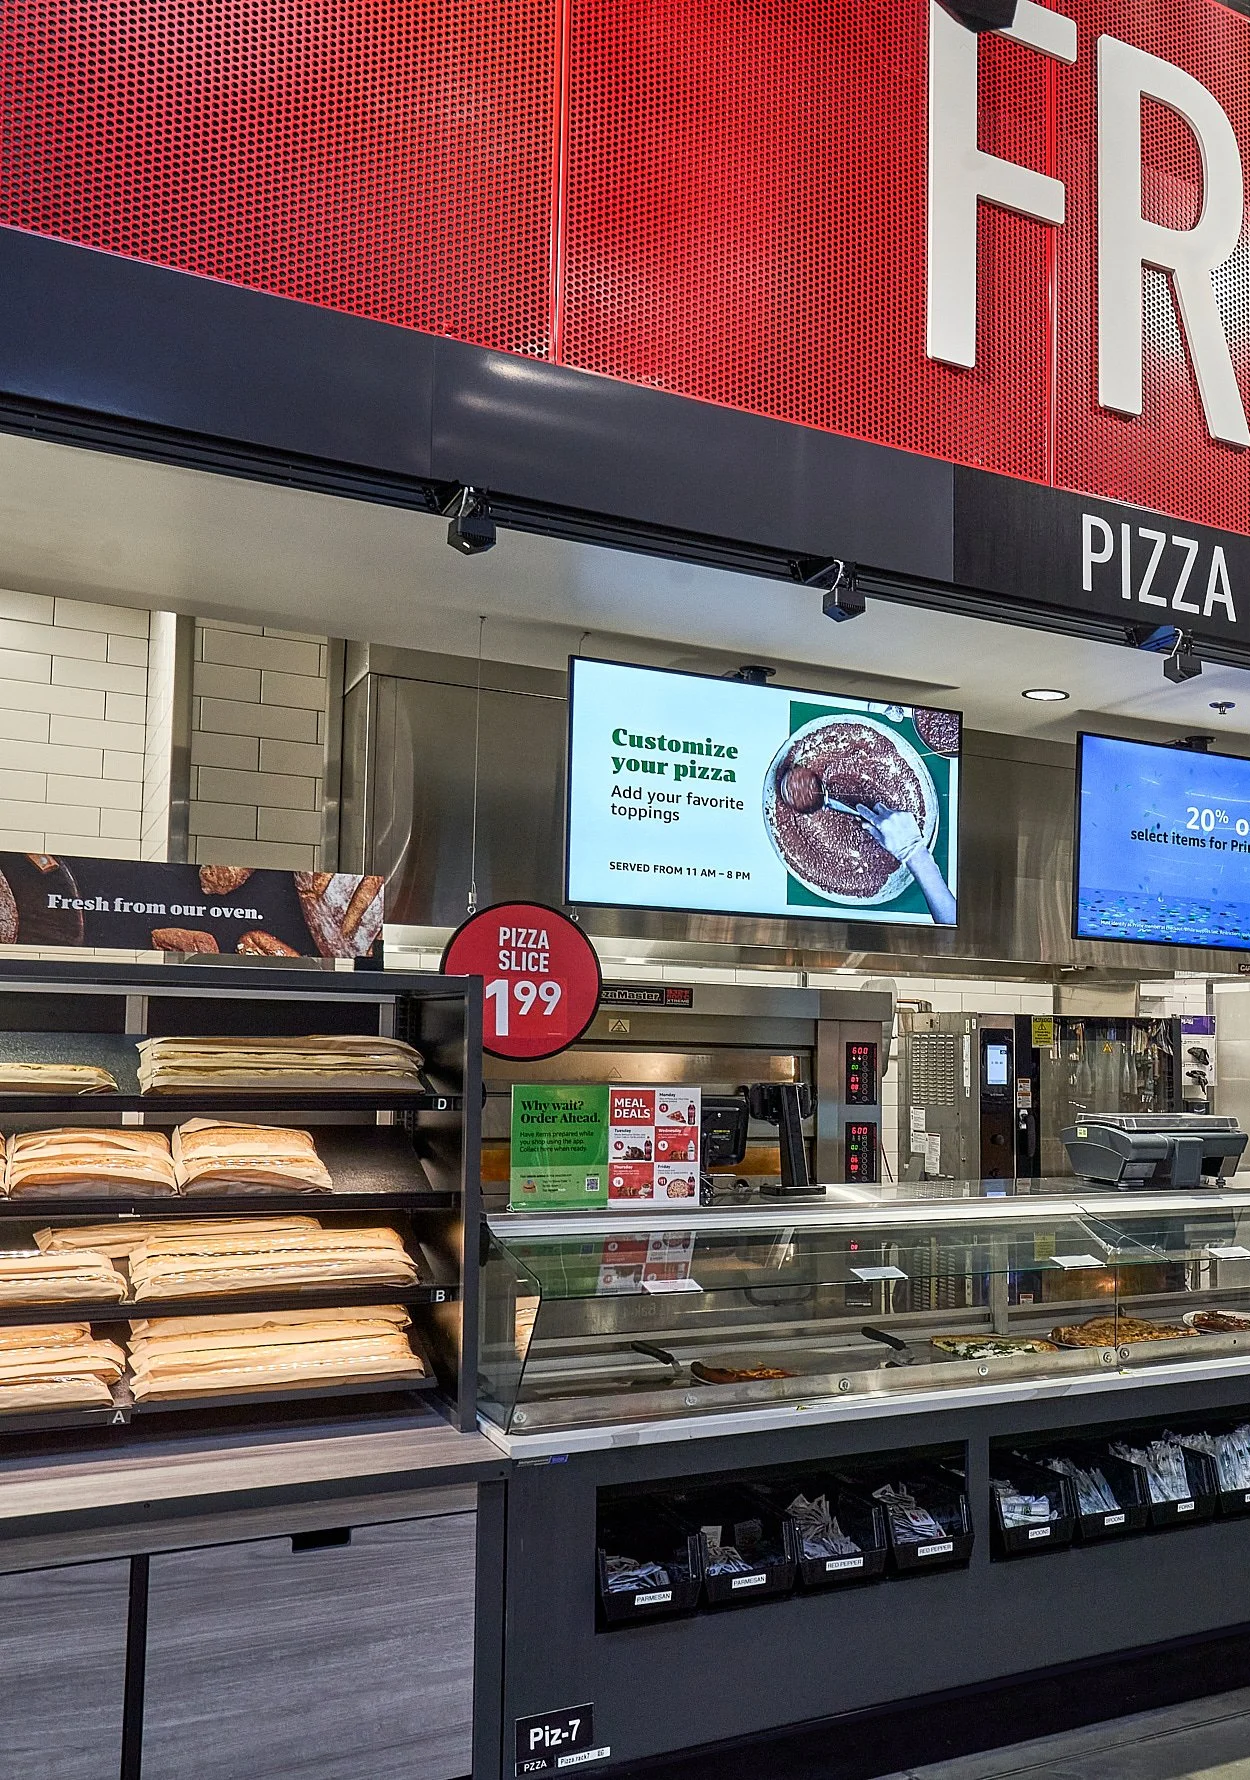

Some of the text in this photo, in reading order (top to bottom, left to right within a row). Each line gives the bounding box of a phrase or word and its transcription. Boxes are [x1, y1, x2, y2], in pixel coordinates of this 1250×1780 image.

[1082, 513, 1237, 622] PIZZA
[612, 728, 739, 759] Customize
[611, 756, 737, 783] your pizza
[611, 785, 744, 810] Add your favorite
[611, 803, 680, 823] toppings
[1186, 806, 1229, 832] 20%
[1130, 828, 1169, 845] select
[1171, 832, 1206, 848] items
[1209, 836, 1227, 851] for
[609, 861, 650, 873] SERVED
[653, 865, 683, 875] FROM
[686, 867, 697, 876] 11
[700, 868, 716, 878] AM
[727, 871, 733, 879] 8
[736, 871, 751, 880] PM
[47, 894, 264, 920] Fresh from our oven.
[499, 927, 550, 949] PIZZA
[498, 950, 550, 973] SLICE
[437, 1098, 447, 1110] D
[521, 1100, 584, 1113] Why wait?
[614, 1098, 646, 1108] MEAL
[521, 1112, 600, 1124] Order Ahead.
[614, 1109, 651, 1119] DEALS
[851, 1127, 868, 1135] 600
[435, 1290, 446, 1302] B
[112, 1410, 126, 1424] A
[1029, 1528, 1049, 1537] SPOONS
[919, 1543, 952, 1555] RED PEPPER
[827, 1559, 862, 1570] RED PEPPER
[733, 1575, 765, 1587] PARMESAN
[636, 1593, 671, 1604] PARMESAN
[529, 1718, 581, 1751] Piz-7
[523, 1760, 548, 1773] PZZA
